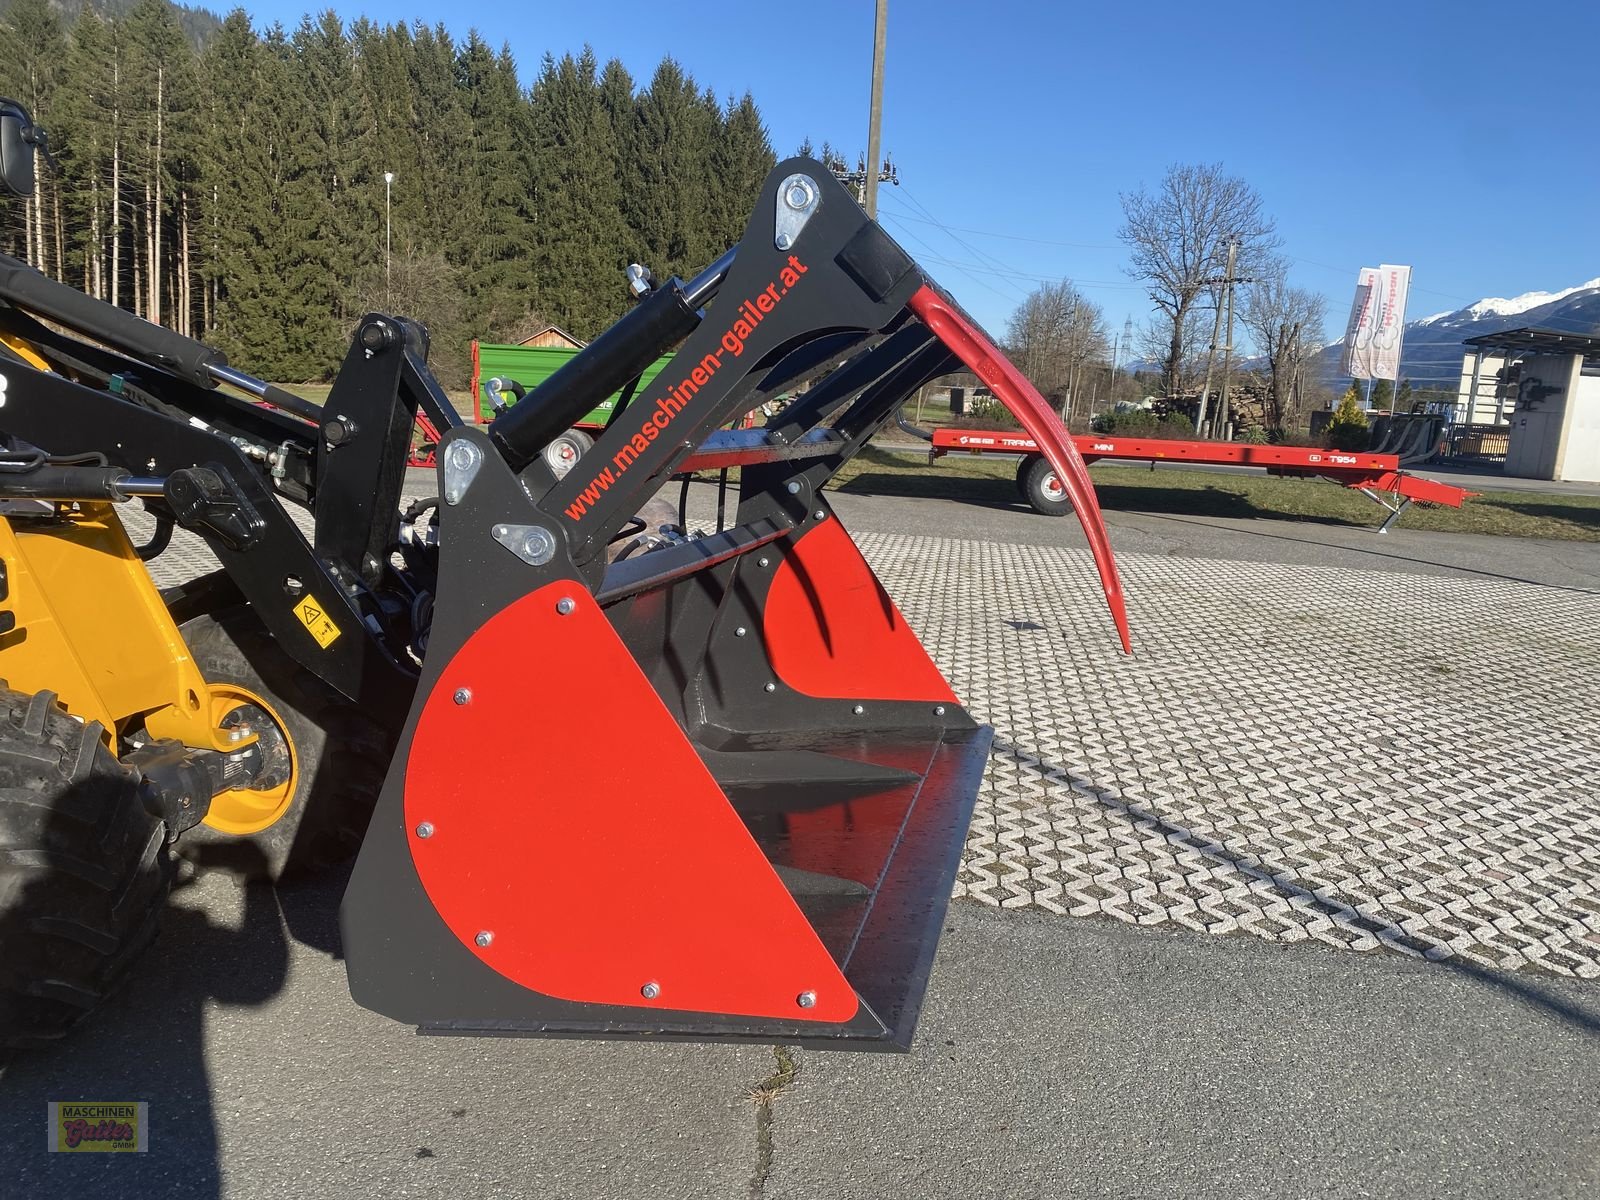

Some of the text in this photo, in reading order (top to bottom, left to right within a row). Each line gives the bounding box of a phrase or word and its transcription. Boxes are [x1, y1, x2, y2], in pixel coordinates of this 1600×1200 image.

[564, 254, 808, 521] www.maschinen-gailer.at
[1094, 443, 1114, 451] MINI
[1329, 455, 1357, 464] T954
